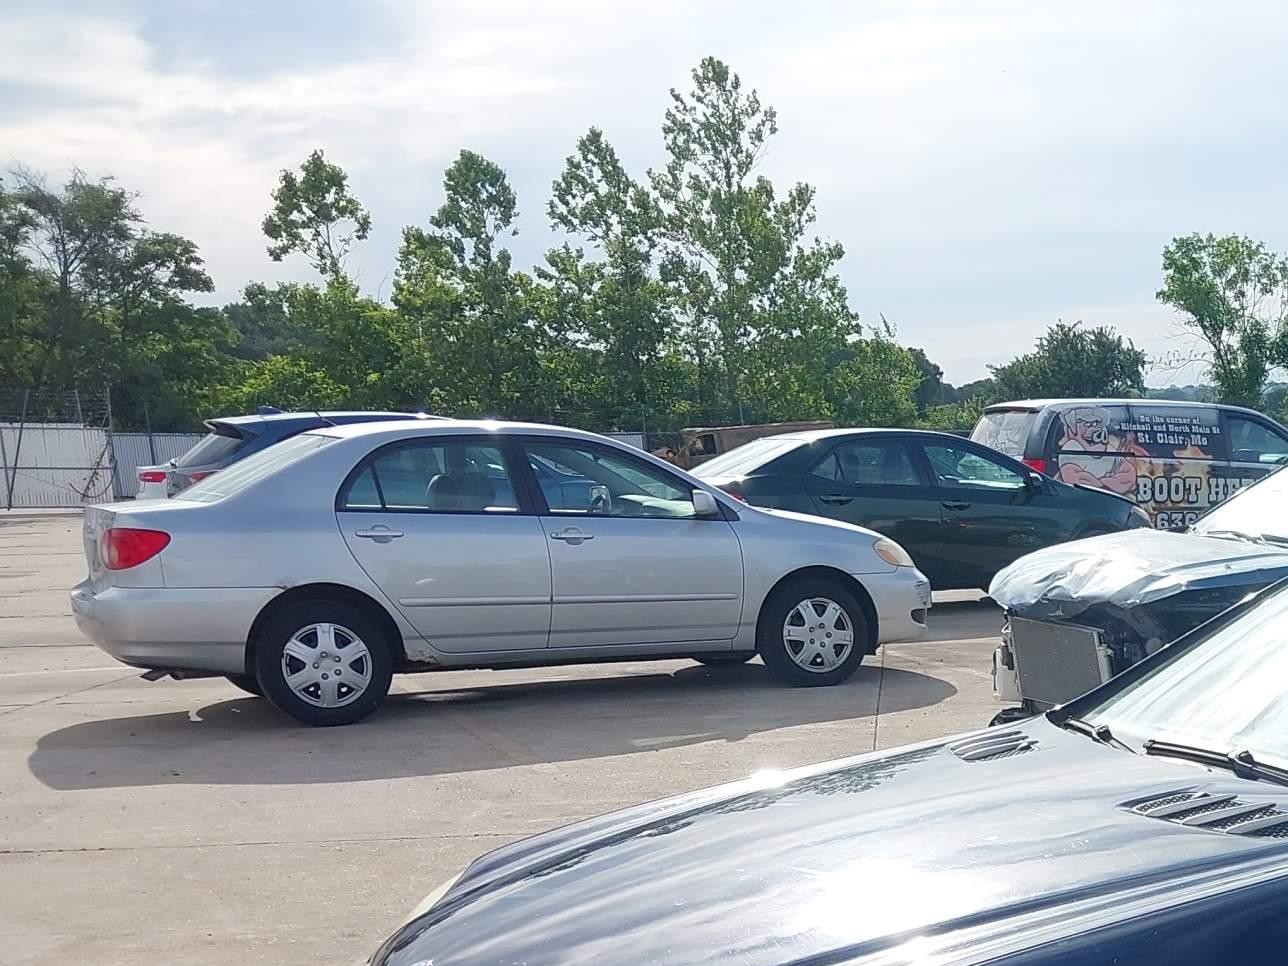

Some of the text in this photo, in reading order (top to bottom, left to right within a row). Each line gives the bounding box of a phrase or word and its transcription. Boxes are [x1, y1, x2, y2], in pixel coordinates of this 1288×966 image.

[1166, 416, 1190, 424] corner
[1153, 424, 1167, 432] and
[1168, 424, 1190, 433] North
[1191, 426, 1211, 434] Main
[1212, 426, 1221, 434] St
[1137, 432, 1208, 447] St. Clair, Mo
[1136, 477, 1201, 503] BOOT
